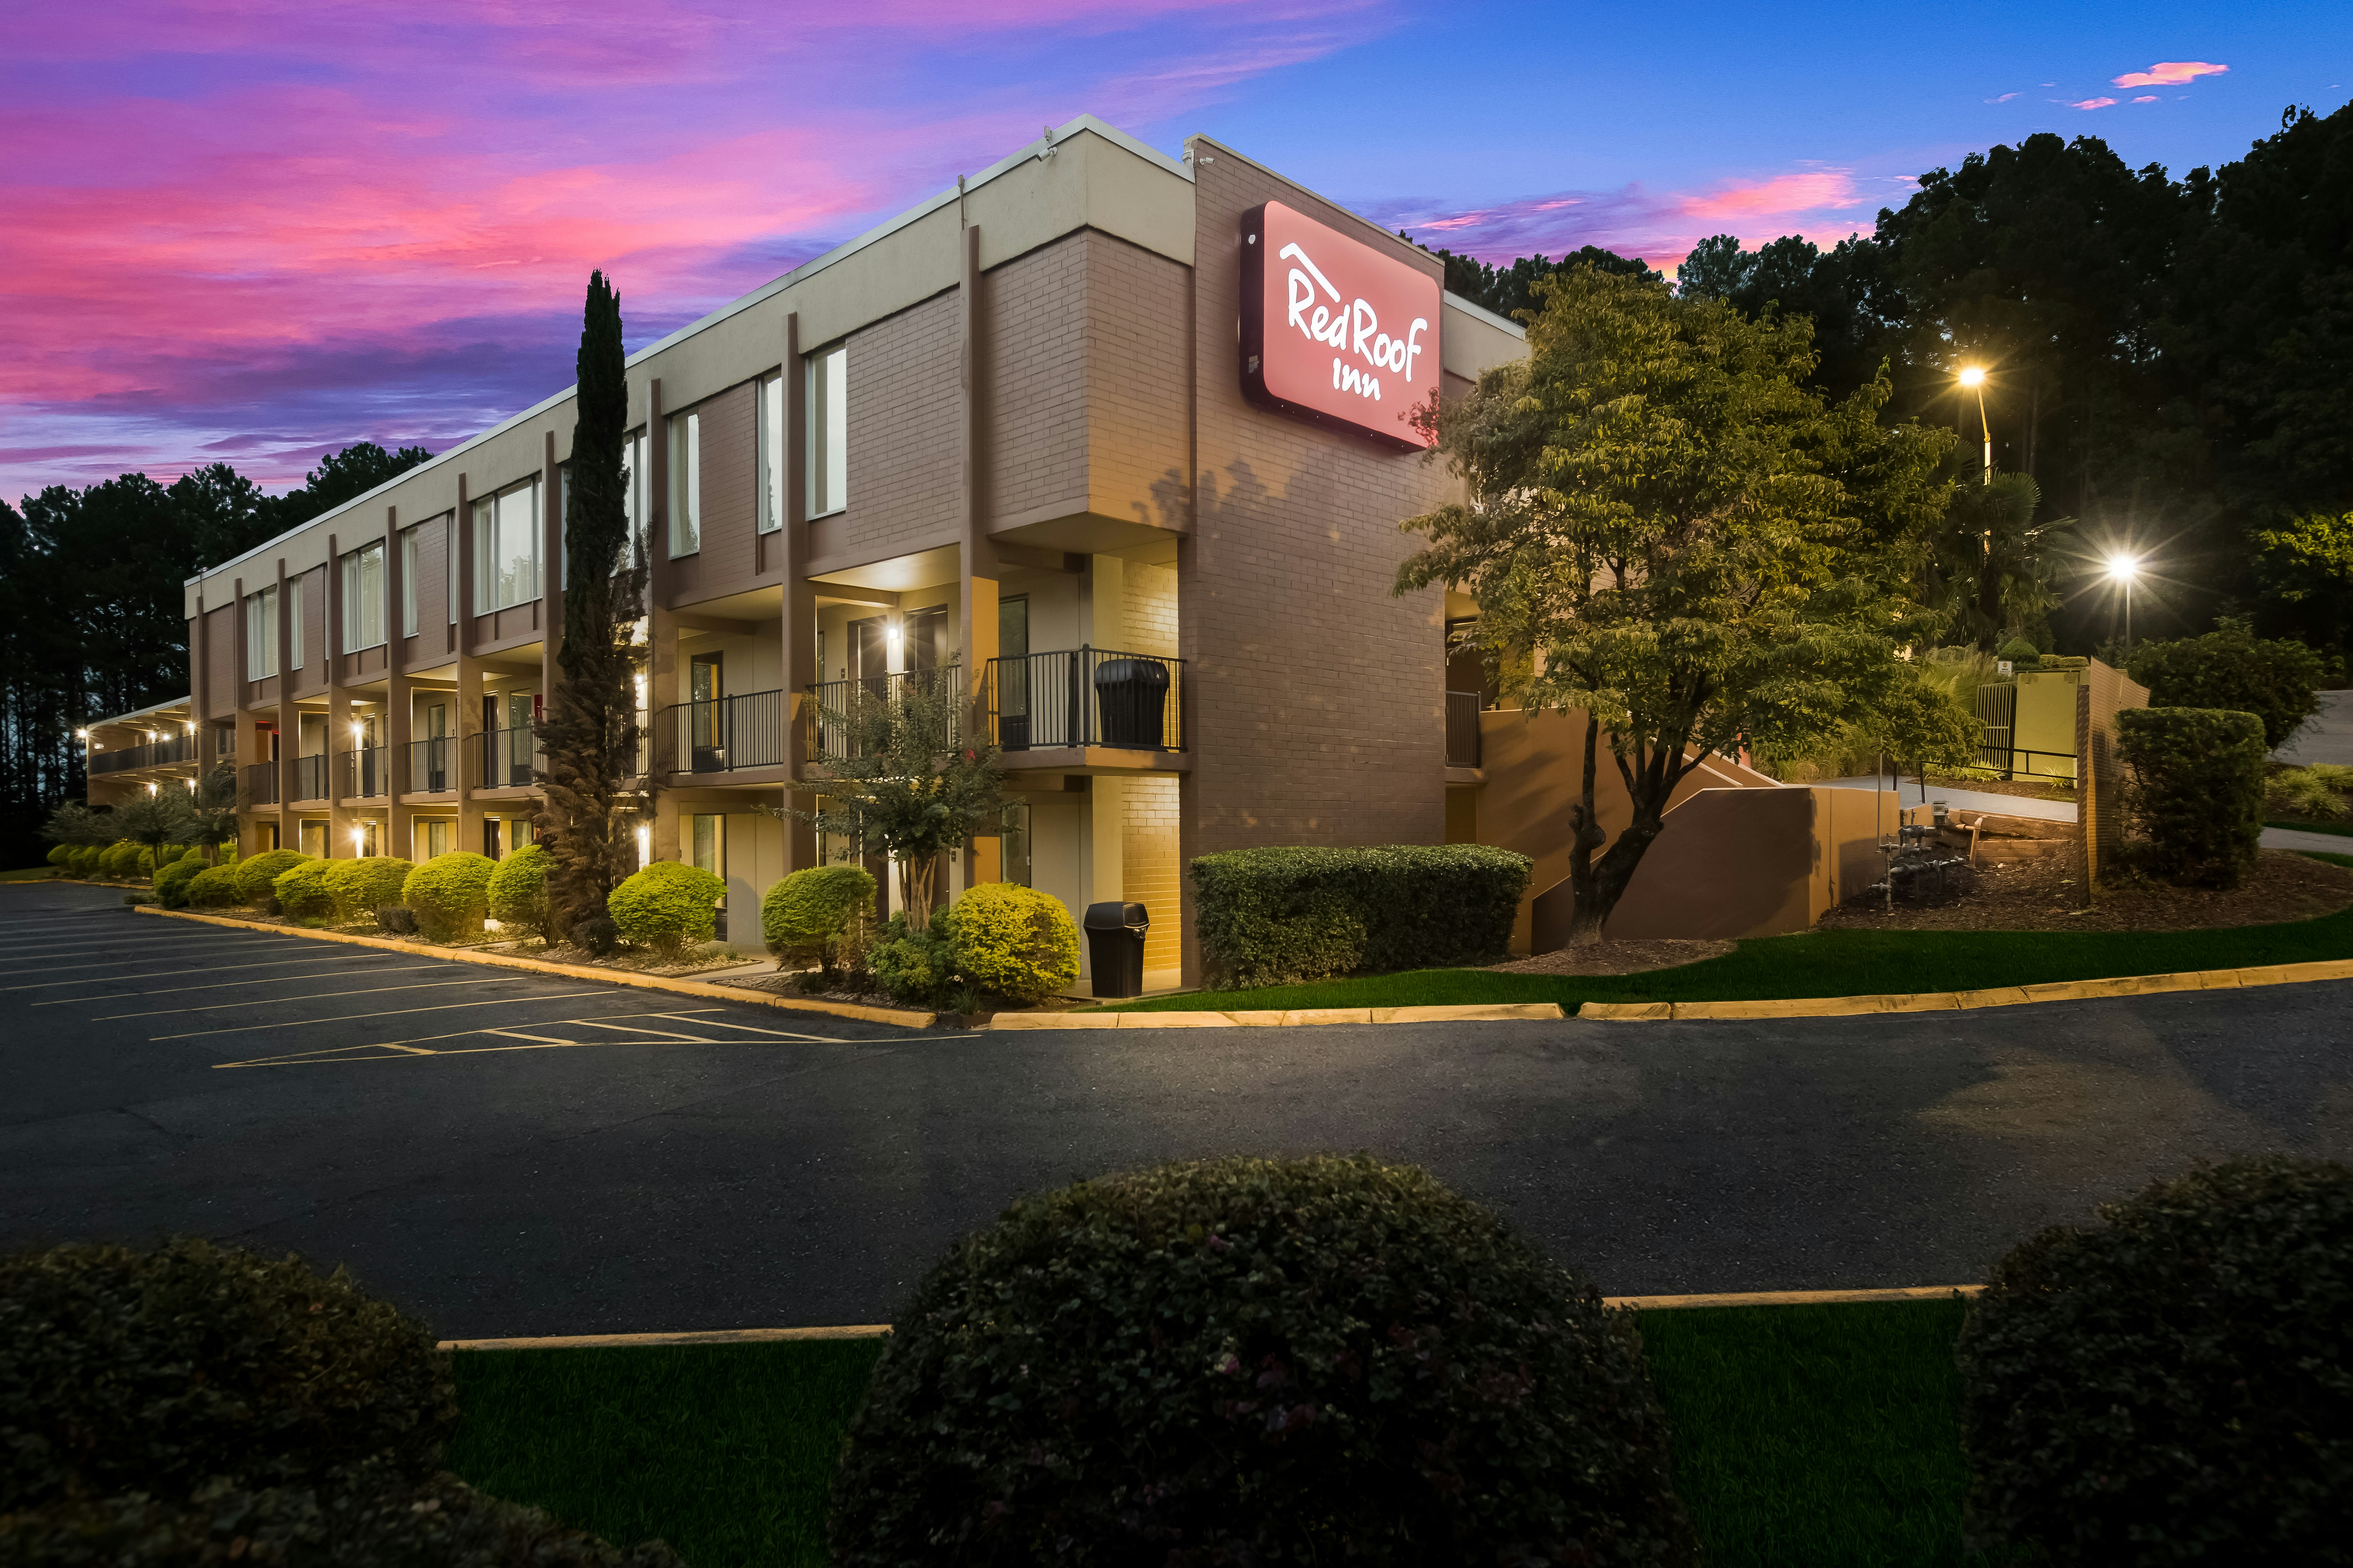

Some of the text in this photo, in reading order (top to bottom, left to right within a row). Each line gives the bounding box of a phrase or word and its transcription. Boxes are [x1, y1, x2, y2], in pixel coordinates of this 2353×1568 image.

[1288, 268, 1428, 382] Red Roof
[1333, 358, 1381, 401] Inn
